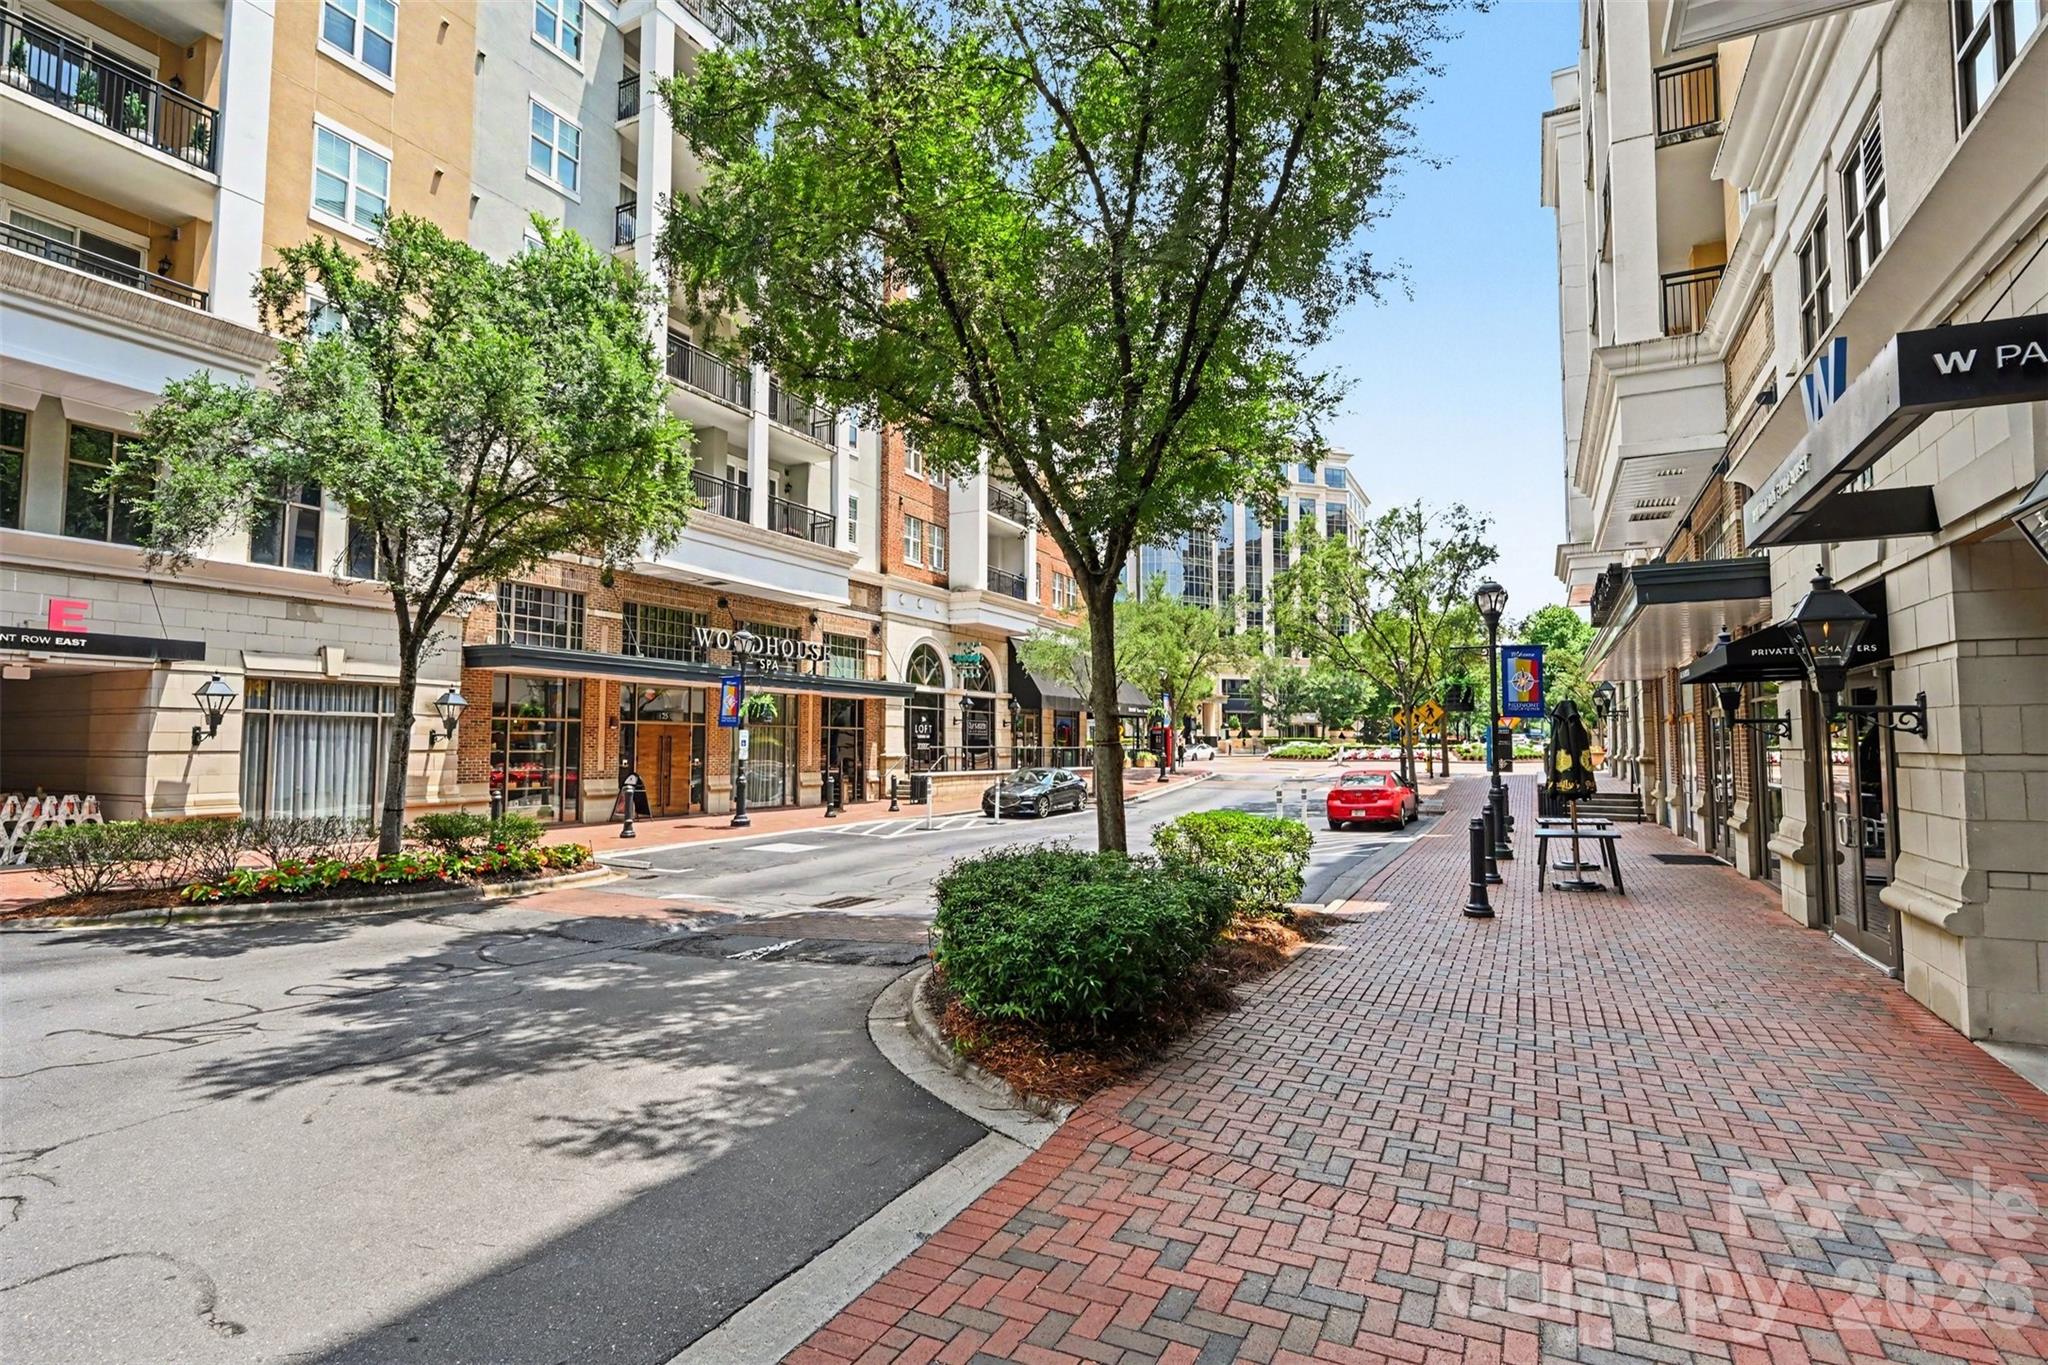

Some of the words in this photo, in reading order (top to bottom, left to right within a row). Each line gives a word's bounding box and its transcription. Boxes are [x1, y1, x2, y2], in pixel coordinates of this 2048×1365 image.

[1933, 349, 1977, 375] W
[1996, 341, 2048, 369] PA
[48, 597, 89, 633] E
[21, 634, 52, 645] ROW
[55, 637, 88, 647] EAST
[694, 627, 832, 663] WODHOUSE
[1751, 648, 1794, 656] PRIVATE
[1818, 644, 1878, 654] CHAERS
[760, 658, 779, 671] SPA
